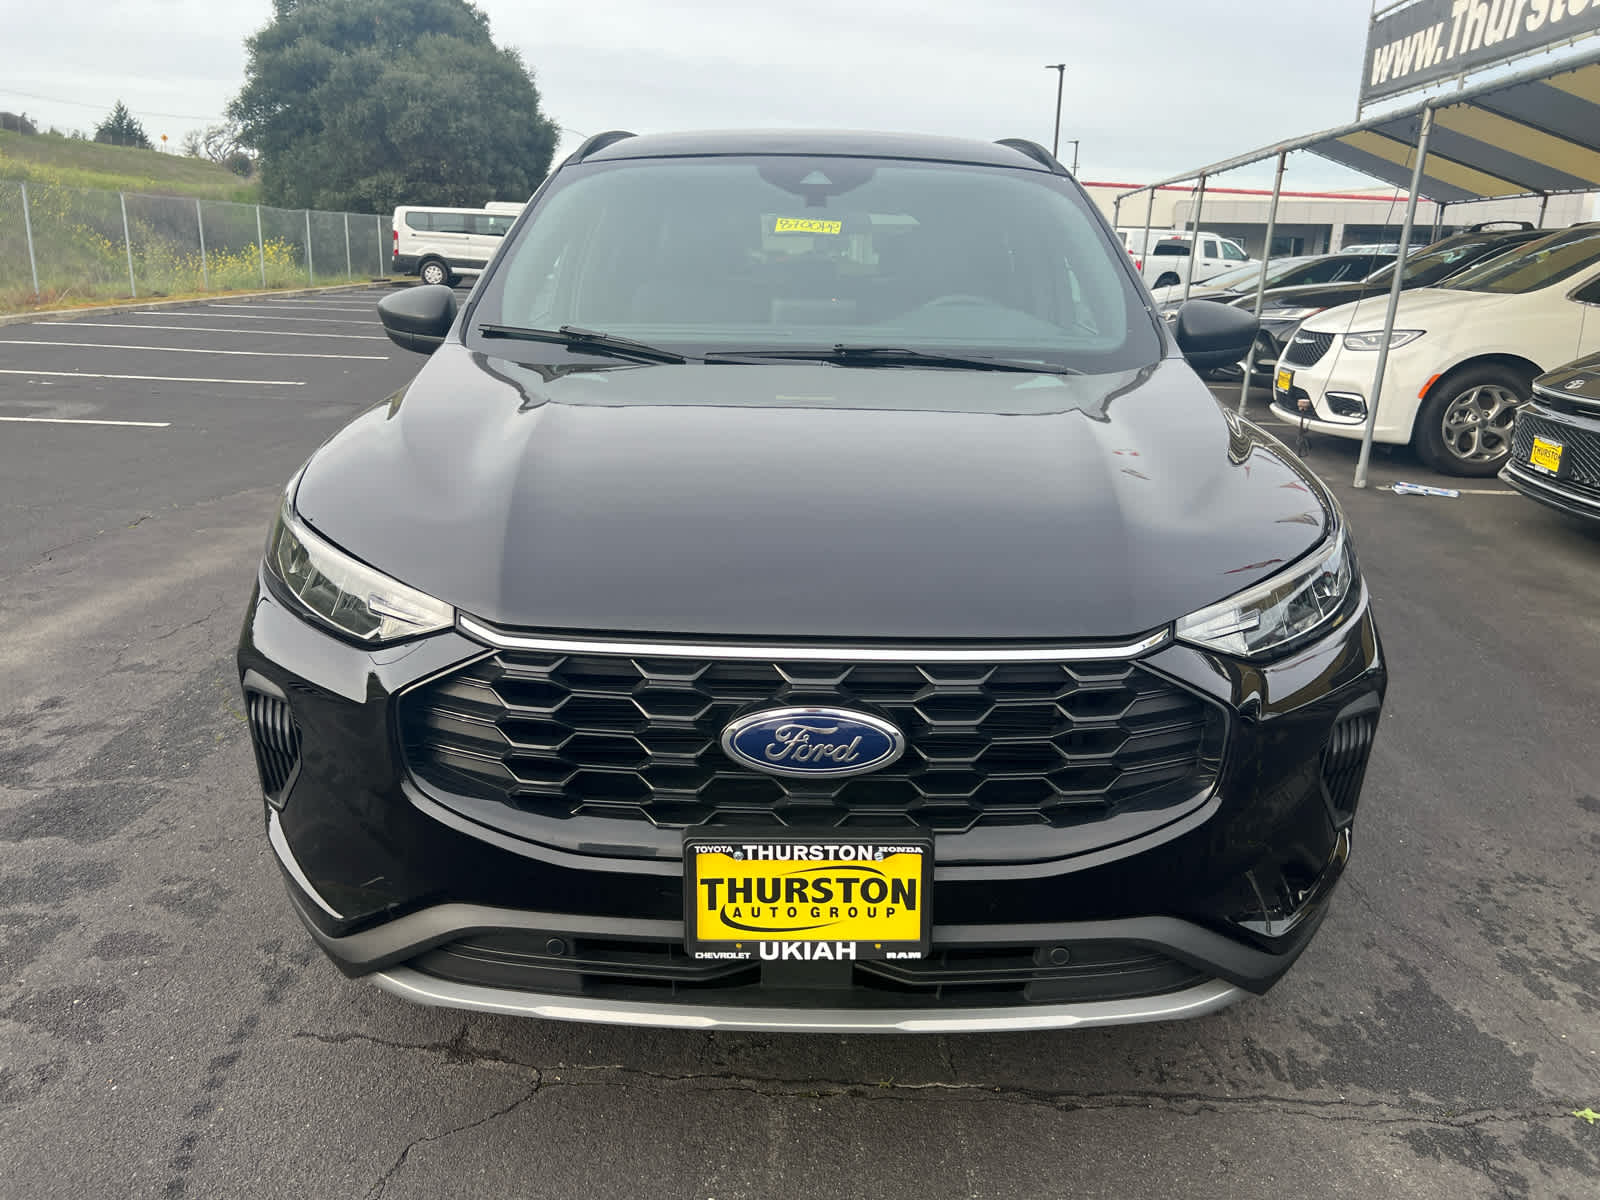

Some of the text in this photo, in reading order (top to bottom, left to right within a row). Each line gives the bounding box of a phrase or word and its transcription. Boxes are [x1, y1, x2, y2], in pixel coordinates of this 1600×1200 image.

[765, 724, 862, 762] Ford
[742, 845, 873, 860] THURSTON
[700, 877, 916, 911] THURSTON
[733, 906, 896, 918] AUTO GROUP
[759, 941, 856, 960] UKIAH
